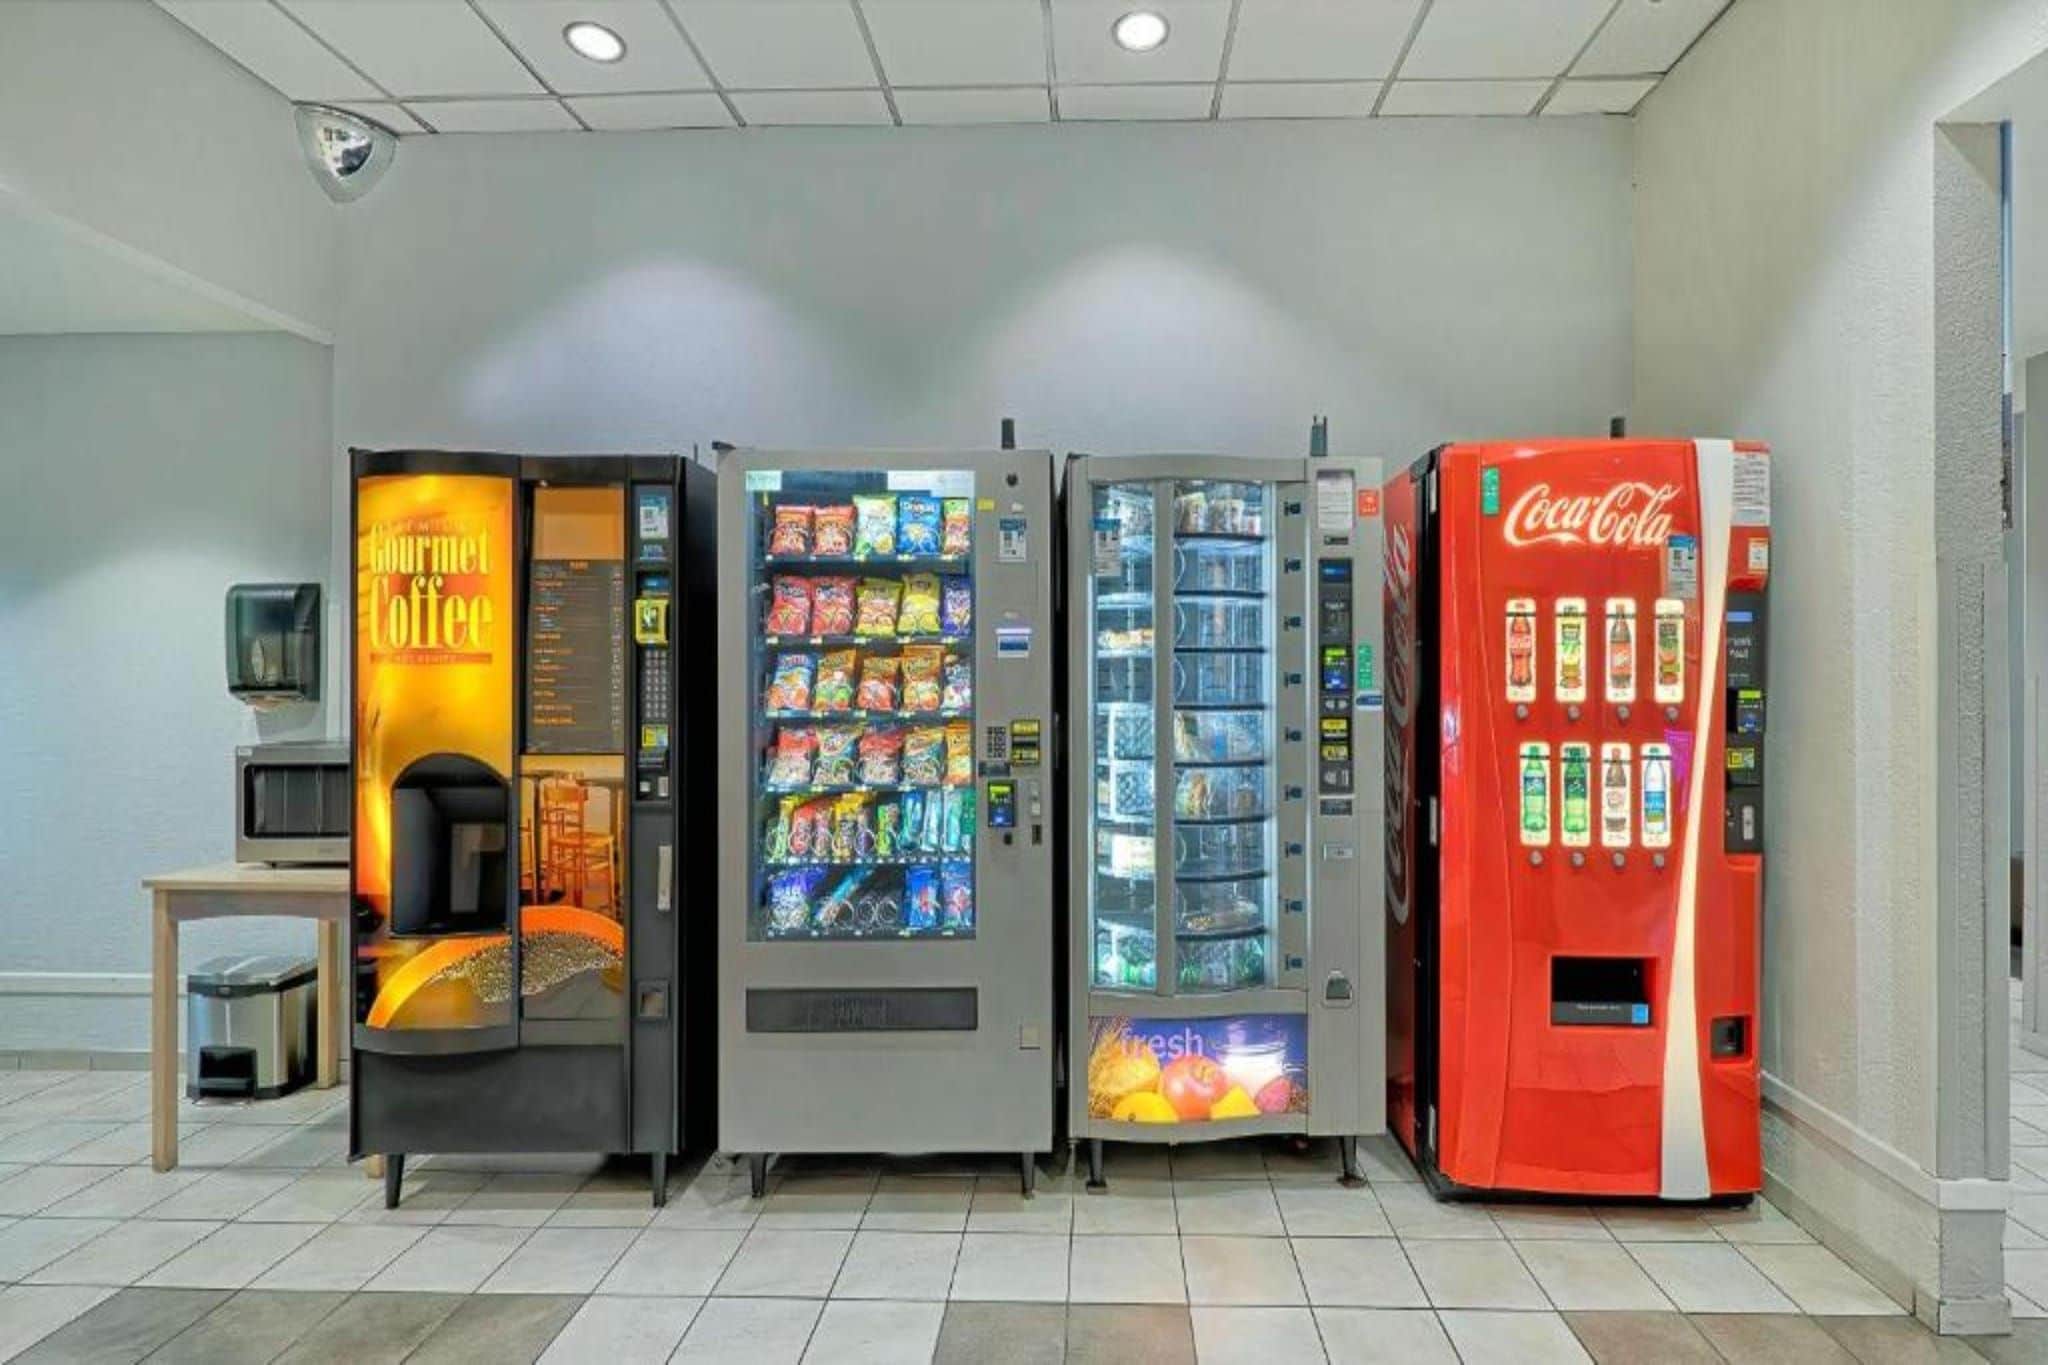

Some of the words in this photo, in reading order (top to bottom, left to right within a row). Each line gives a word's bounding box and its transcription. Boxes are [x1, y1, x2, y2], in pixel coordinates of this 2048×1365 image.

[1503, 482, 1681, 546] Coca-Cola
[370, 522, 490, 575] Gourmet
[369, 575, 493, 648] Coffee
[1121, 1027, 1203, 1058] fresh
